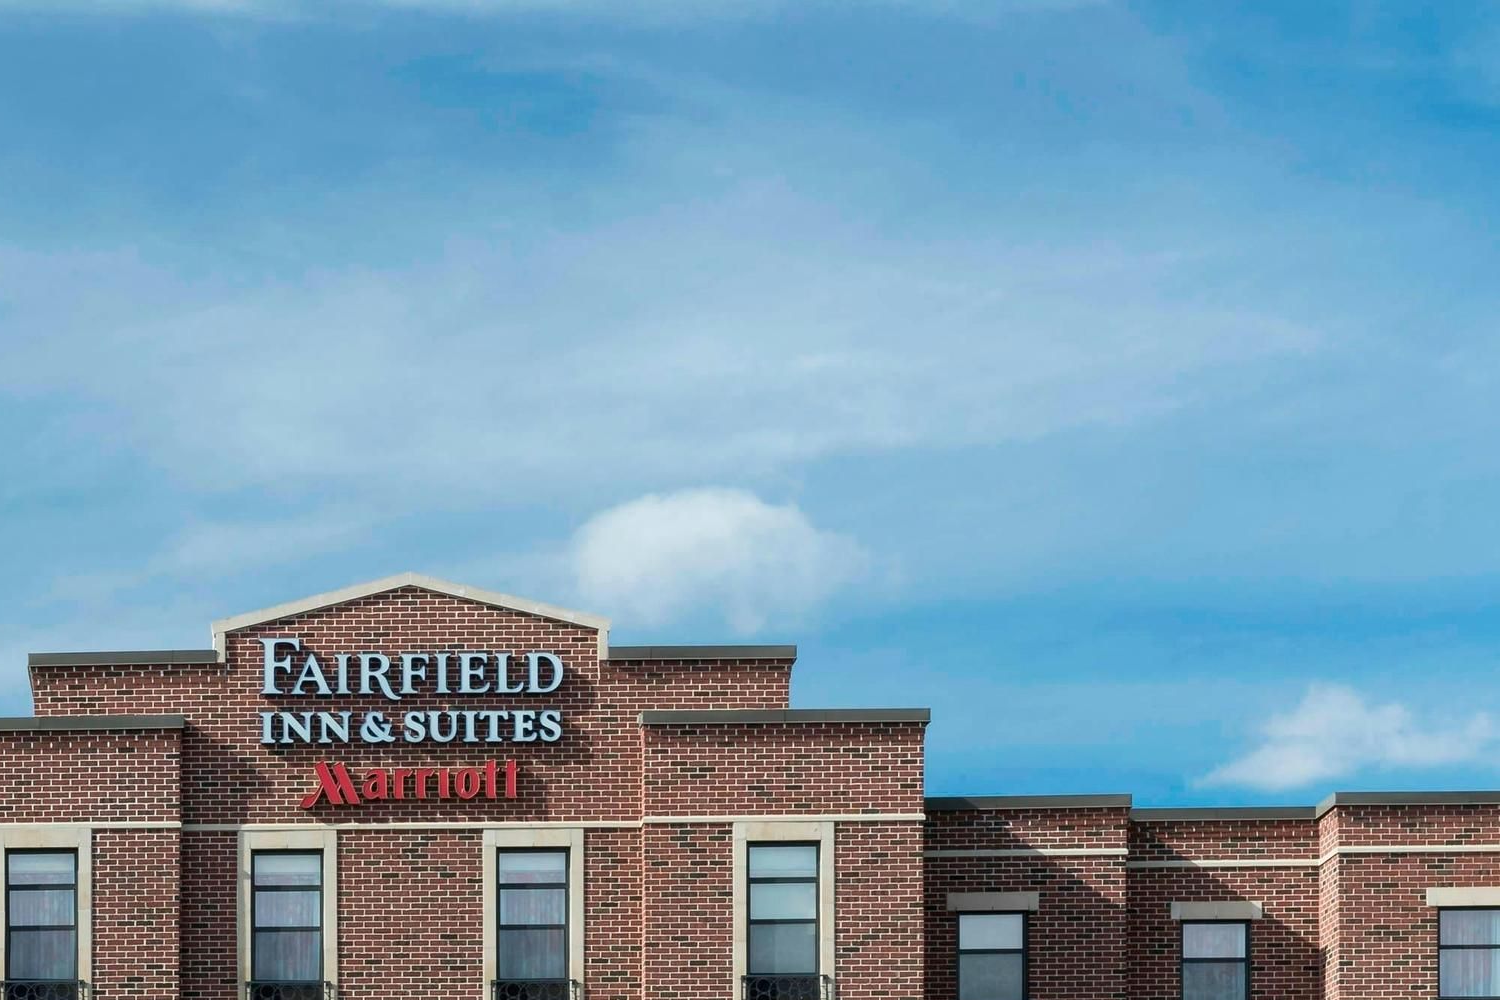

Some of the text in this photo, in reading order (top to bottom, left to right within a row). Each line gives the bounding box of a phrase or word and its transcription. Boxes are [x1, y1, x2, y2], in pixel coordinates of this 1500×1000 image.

[258, 637, 564, 700] FAIRFIELD
[259, 709, 562, 744] INN & SUITES
[300, 758, 521, 809] Marriott
